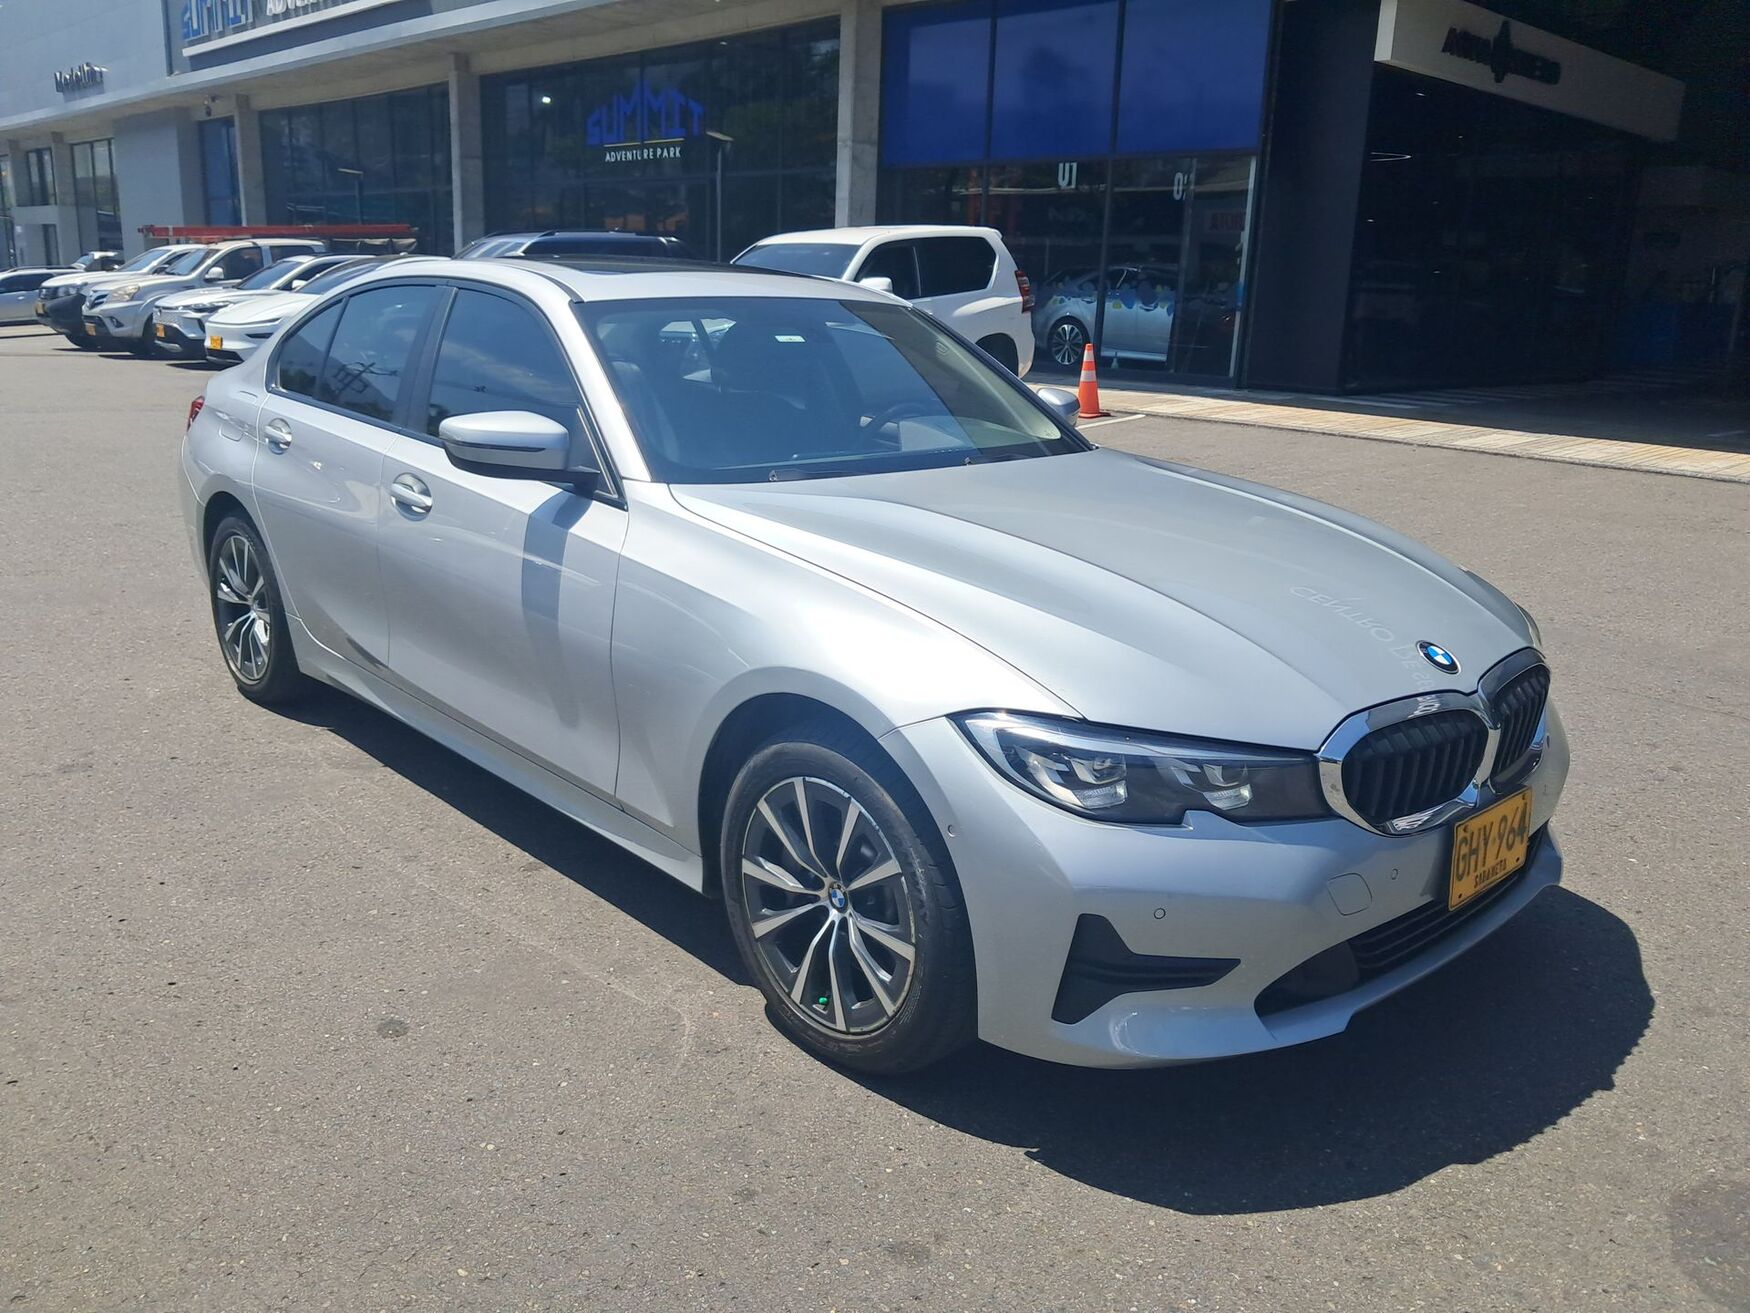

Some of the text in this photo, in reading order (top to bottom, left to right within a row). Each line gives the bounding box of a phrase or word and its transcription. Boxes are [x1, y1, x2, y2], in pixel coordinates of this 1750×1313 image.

[587, 80, 704, 145] SUMMIT
[604, 146, 682, 163] ADVENTURE PARK
